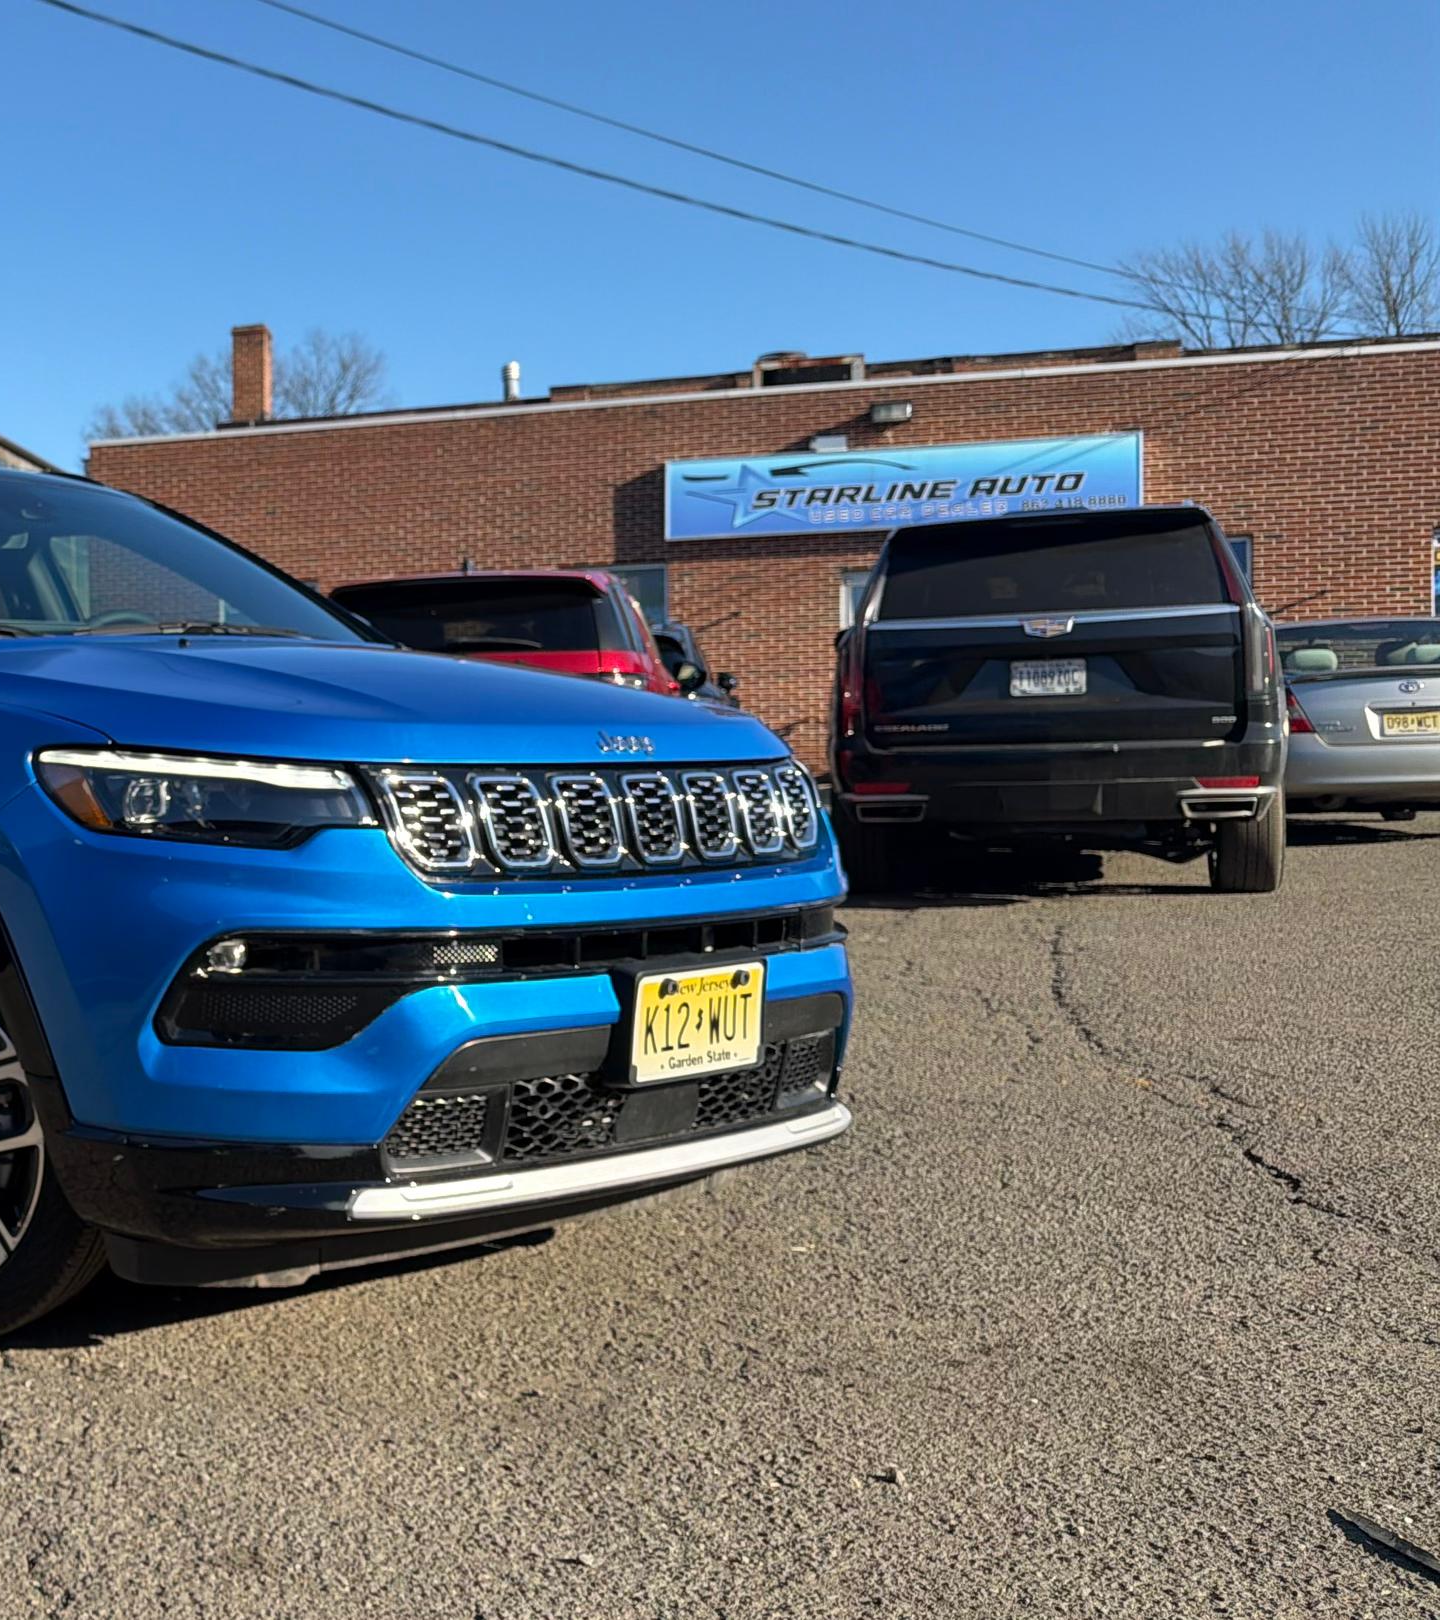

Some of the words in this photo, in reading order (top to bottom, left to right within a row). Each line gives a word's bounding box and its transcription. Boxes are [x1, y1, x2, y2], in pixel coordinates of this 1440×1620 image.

[752, 480, 957, 510] STARLINE
[969, 472, 1085, 499] AUTO
[809, 508, 865, 524] USED
[870, 504, 913, 521] CAR
[921, 500, 1009, 518] DEALER
[596, 730, 655, 756] Jeep
[644, 1002, 691, 1055] K12
[708, 993, 753, 1045] WUT
[668, 1054, 704, 1070] Garden
[707, 1049, 732, 1064] State
